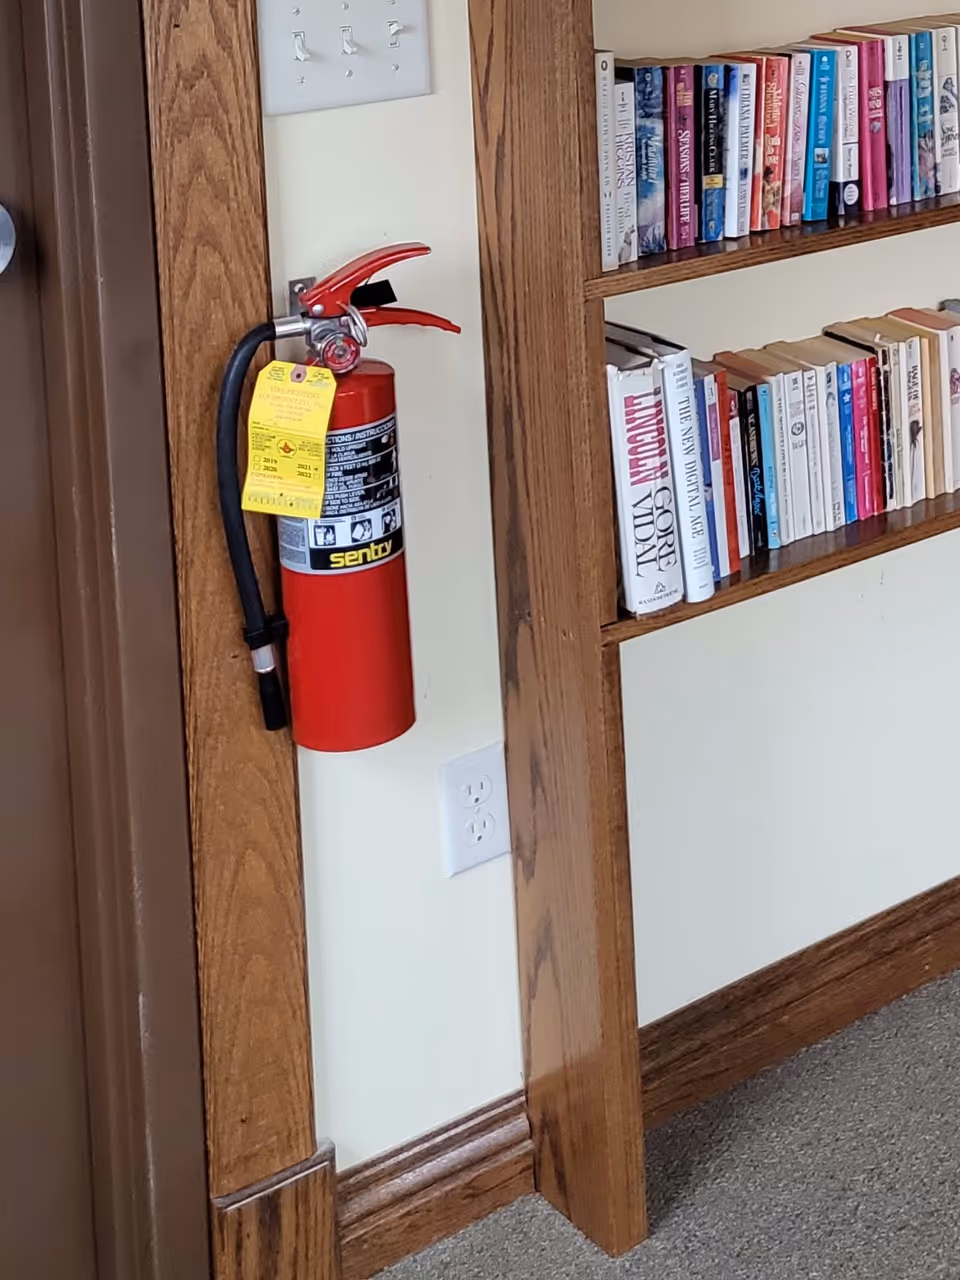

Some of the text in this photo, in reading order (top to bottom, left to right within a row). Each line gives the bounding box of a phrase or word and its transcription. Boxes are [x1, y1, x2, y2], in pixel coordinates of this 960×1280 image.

[708, 89, 718, 173] MARY HIGGINS CLARK
[740, 93, 751, 160] DIANA PALMER
[615, 134, 626, 189] HIGGINS
[625, 132, 635, 186] KRISTAN
[677, 130, 691, 223] SEASONS HER LIFE
[911, 365, 919, 389] RAGE
[677, 396, 696, 424] THE
[262, 456, 278, 465] 2019
[624, 386, 669, 486] LINCOLN
[681, 427, 699, 456] NEW
[297, 463, 312, 471] 2021
[297, 470, 312, 478] 2022
[683, 460, 704, 512] DIGITAL
[750, 467, 763, 516] Dark Angel
[631, 489, 659, 578] VIDAL
[653, 486, 679, 572] GORE
[690, 515, 705, 539] AGE
[329, 539, 392, 568] sentry
